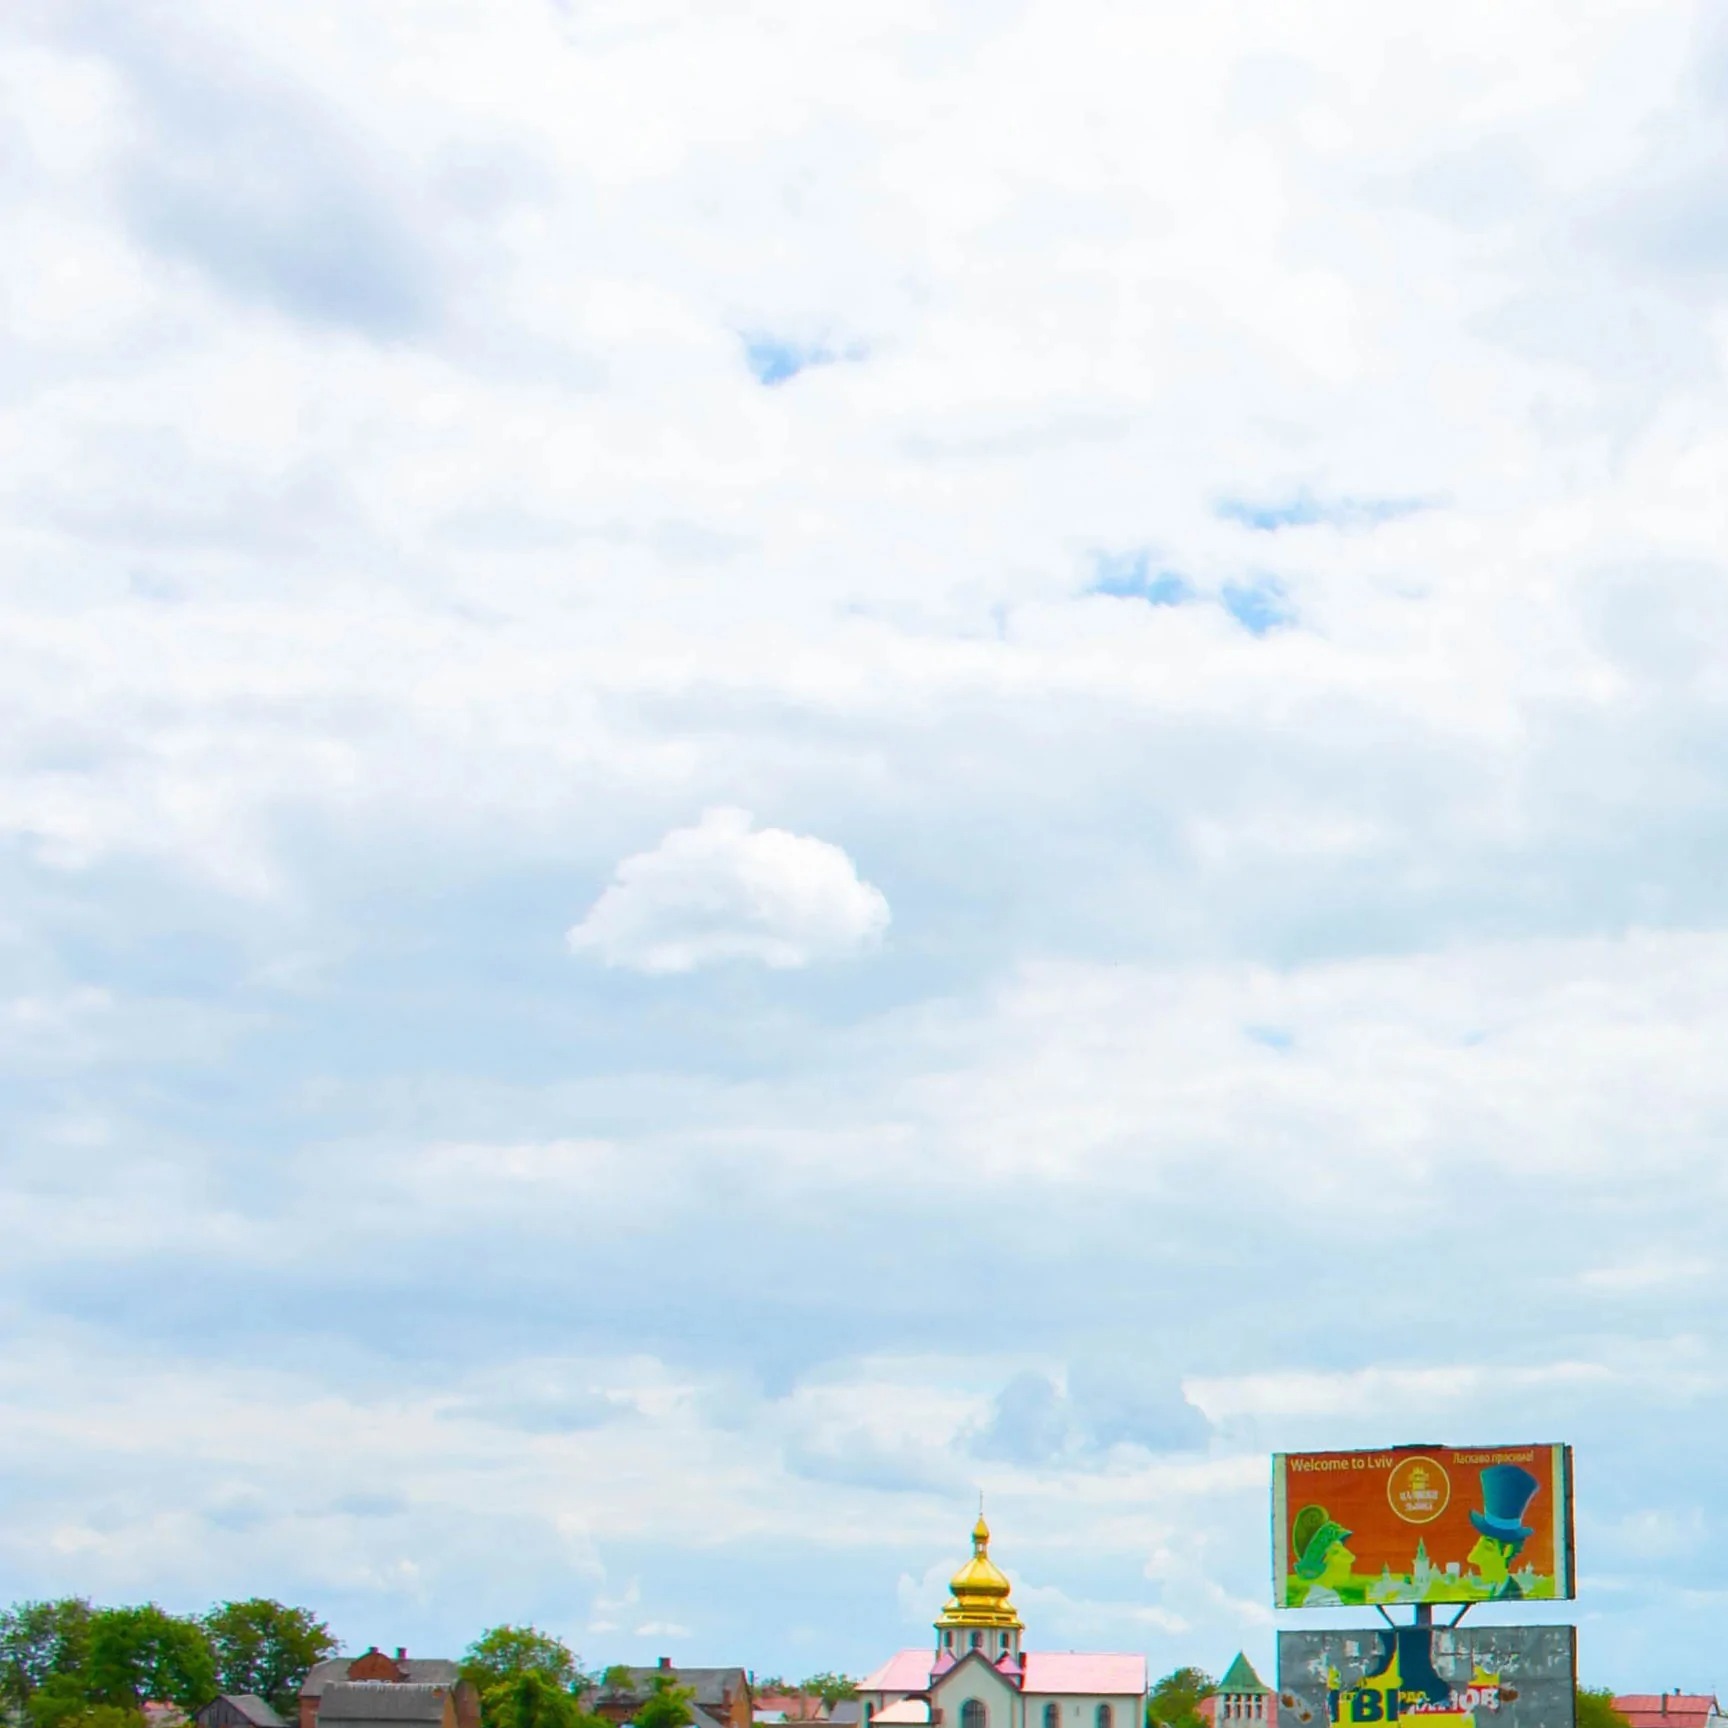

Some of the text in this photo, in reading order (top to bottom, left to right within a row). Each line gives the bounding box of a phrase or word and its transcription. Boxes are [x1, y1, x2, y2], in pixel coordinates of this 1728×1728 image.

[1290, 1454, 1393, 1472] Welcome to Lviv
